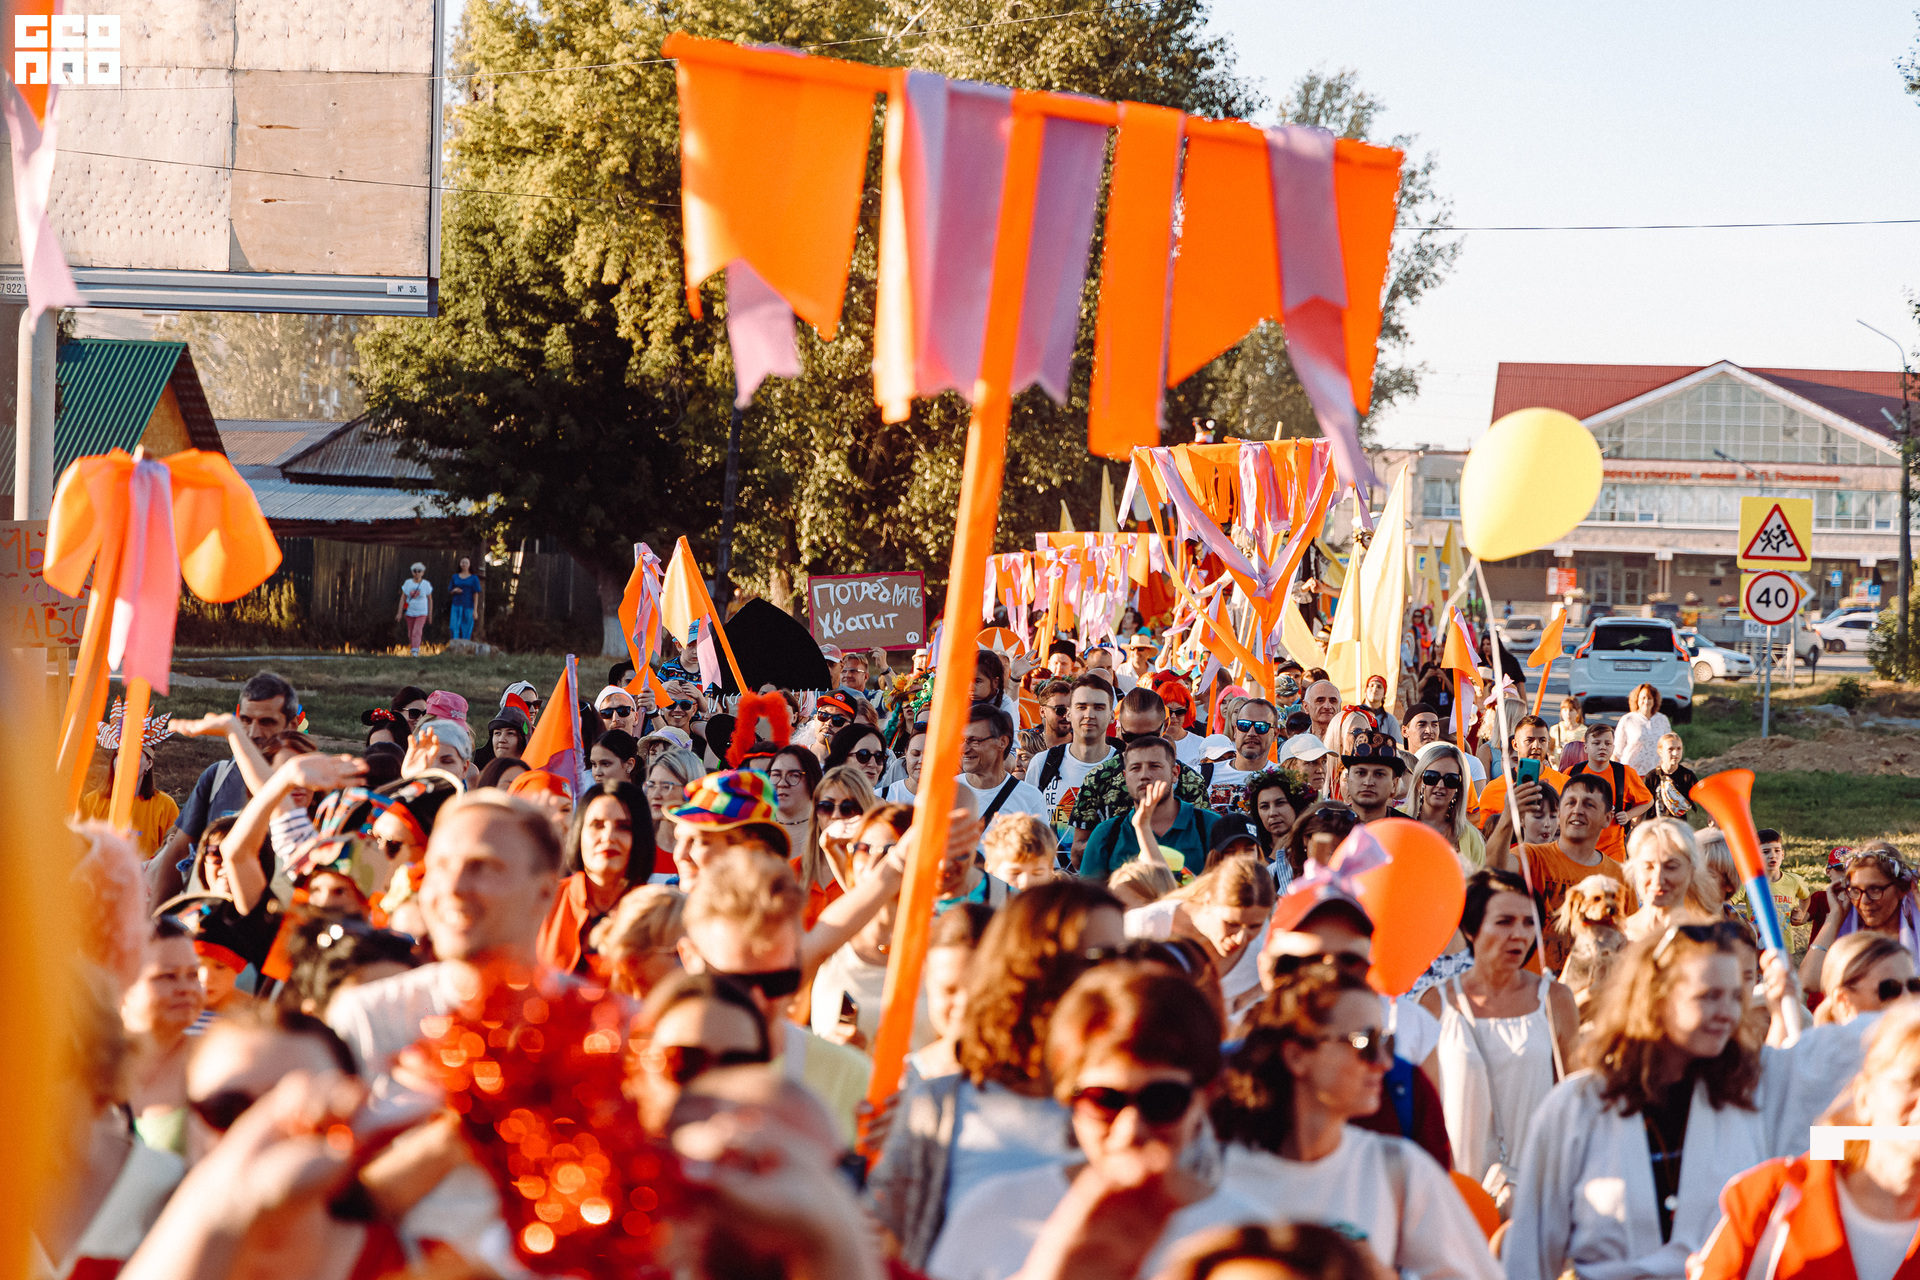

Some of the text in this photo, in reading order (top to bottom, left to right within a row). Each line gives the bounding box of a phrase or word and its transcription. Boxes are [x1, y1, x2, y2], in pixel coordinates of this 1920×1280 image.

[6, 283, 22, 293] 922
[409, 285, 417, 293] 35
[1756, 587, 1788, 608] 40
